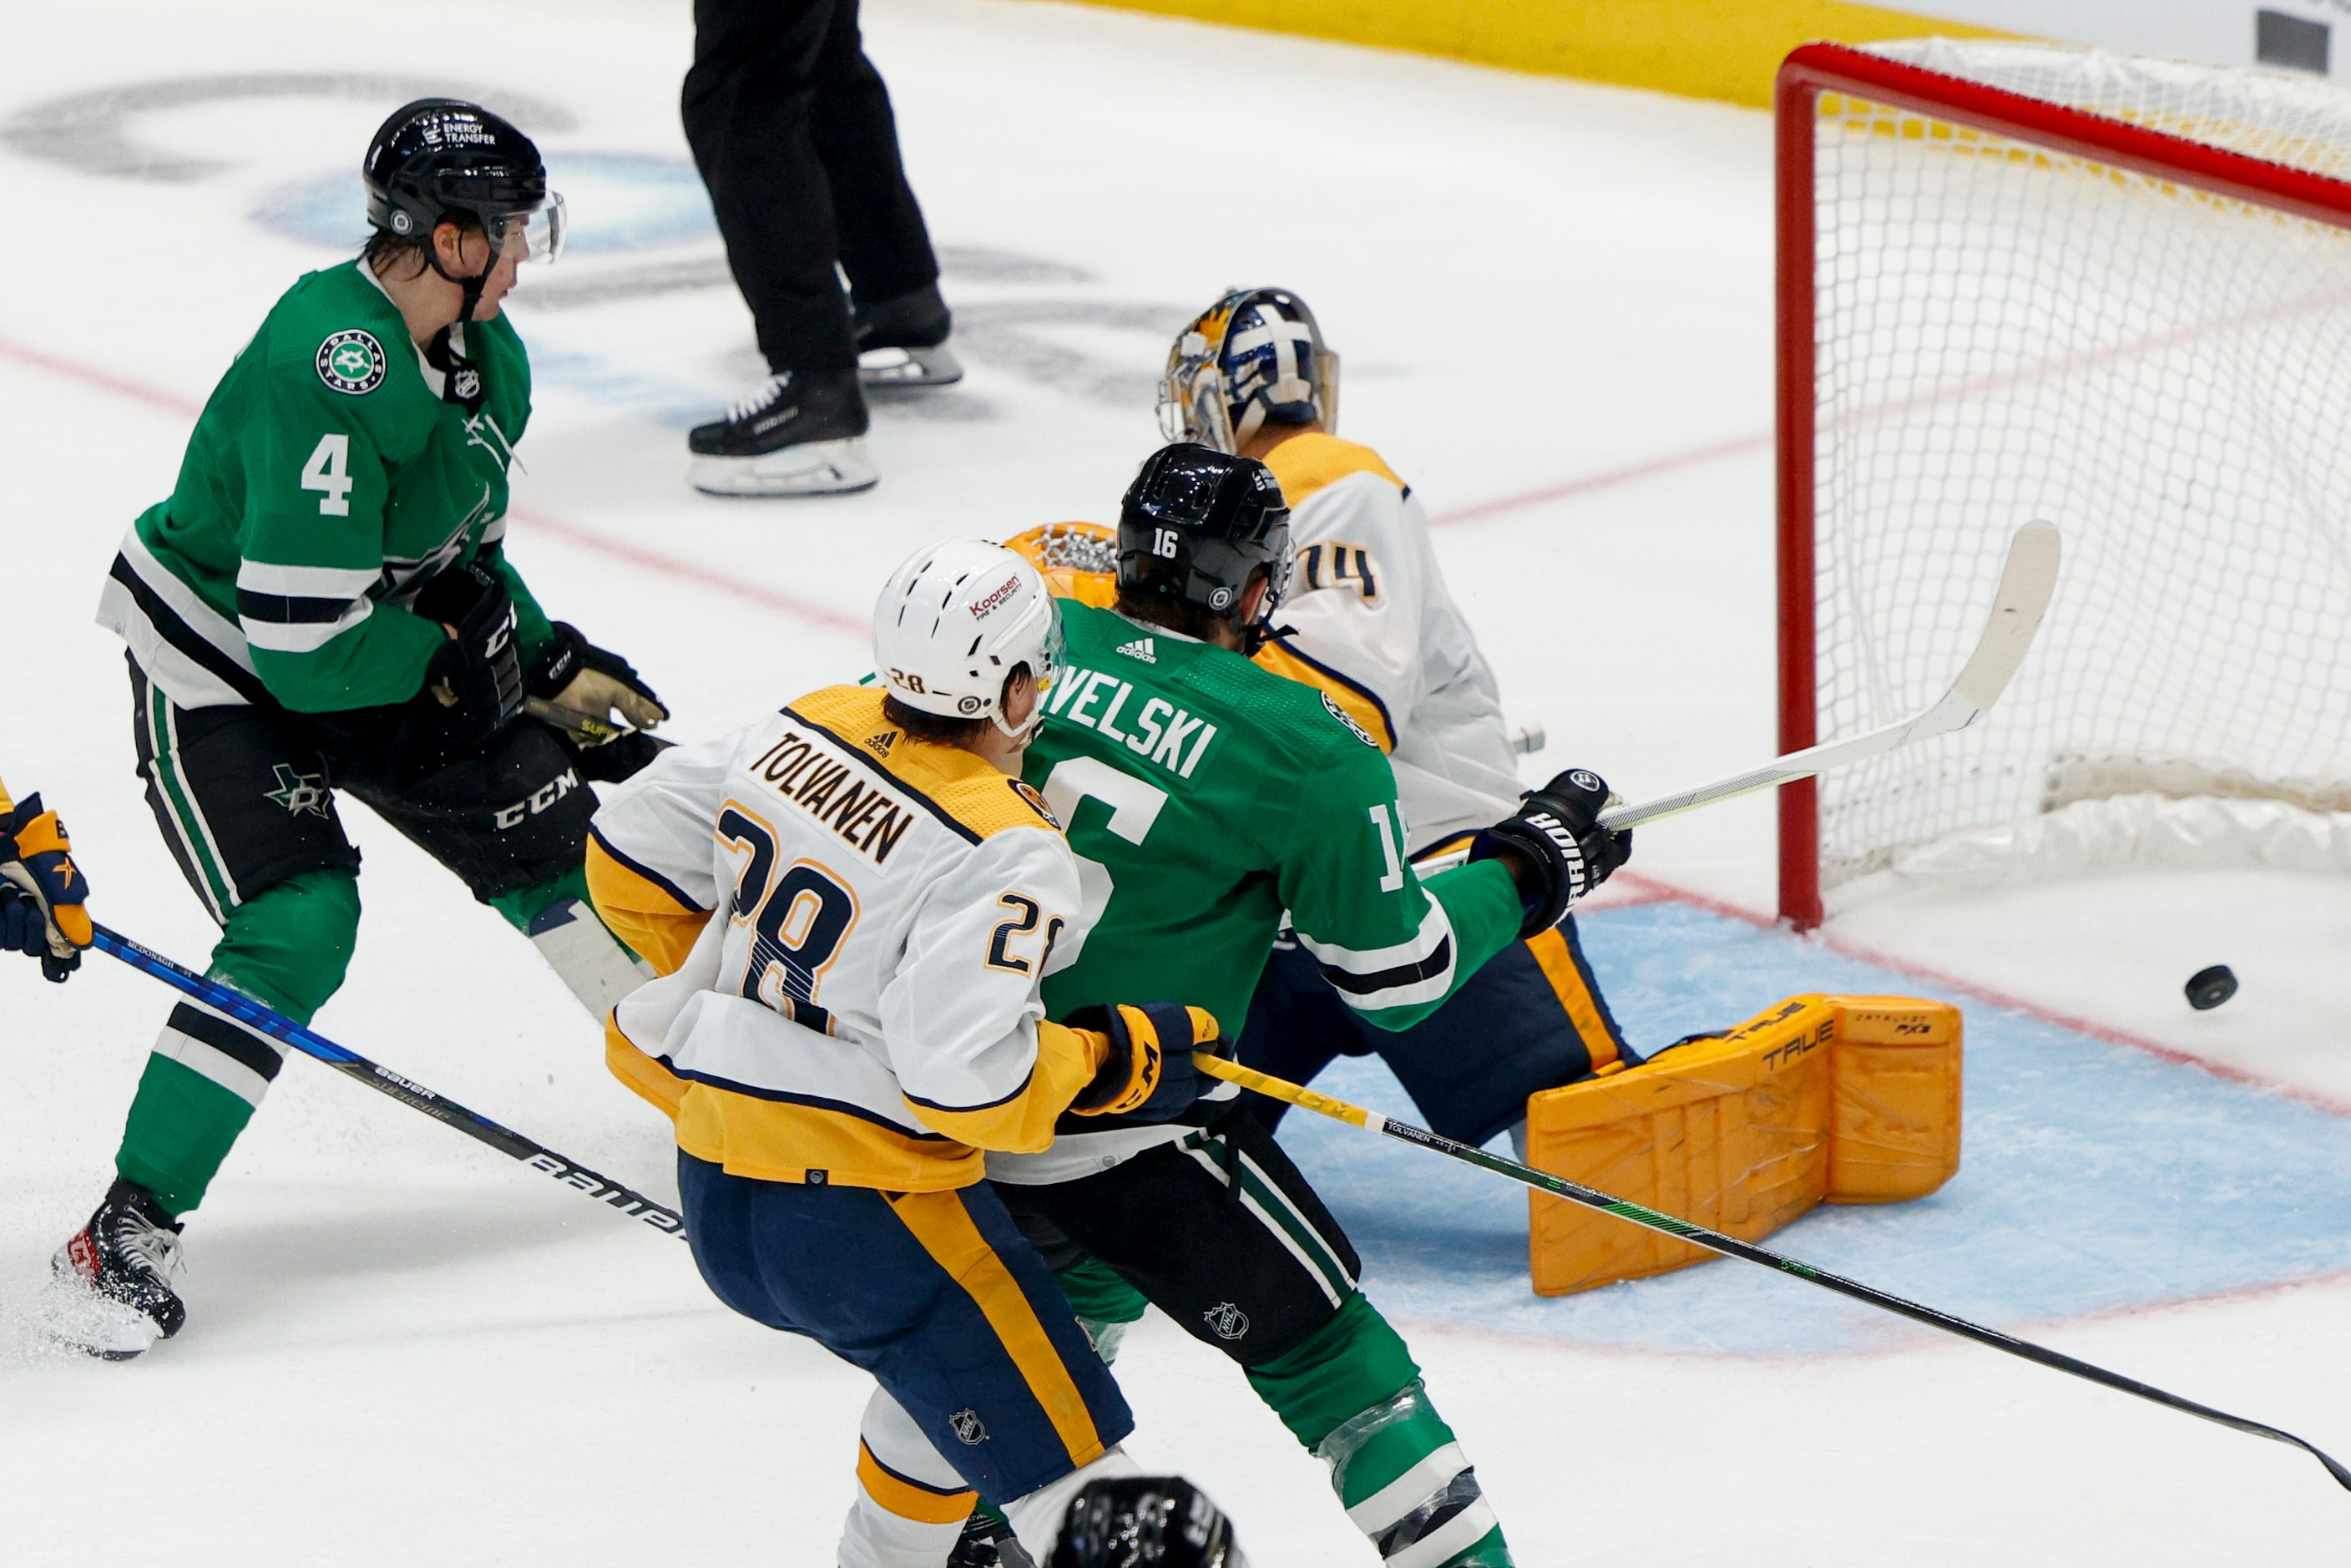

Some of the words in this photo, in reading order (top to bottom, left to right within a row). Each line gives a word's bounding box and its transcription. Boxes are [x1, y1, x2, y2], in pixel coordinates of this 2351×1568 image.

[444, 124, 483, 134] ENERGY
[445, 134, 496, 145] TRANSFER
[330, 333, 383, 373] DALLAS
[320, 357, 369, 390] STARS
[301, 432, 353, 517] 4
[1152, 527, 1179, 559] 16
[969, 575, 1020, 616] Koorsen
[976, 609, 991, 622] FIRE
[999, 583, 1022, 605] SECURITY
[1115, 645, 1157, 665] adidas
[890, 667, 926, 695] 28
[863, 736, 890, 759] adidas
[493, 766, 579, 830] CCM
[749, 731, 916, 867] TOLVANEN
[1368, 799, 1411, 893] 1
[127, 940, 174, 969] MCDONAGH
[1762, 1019, 1835, 1071] TRUE
[1387, 1120, 1431, 1143] TOLVANEN
